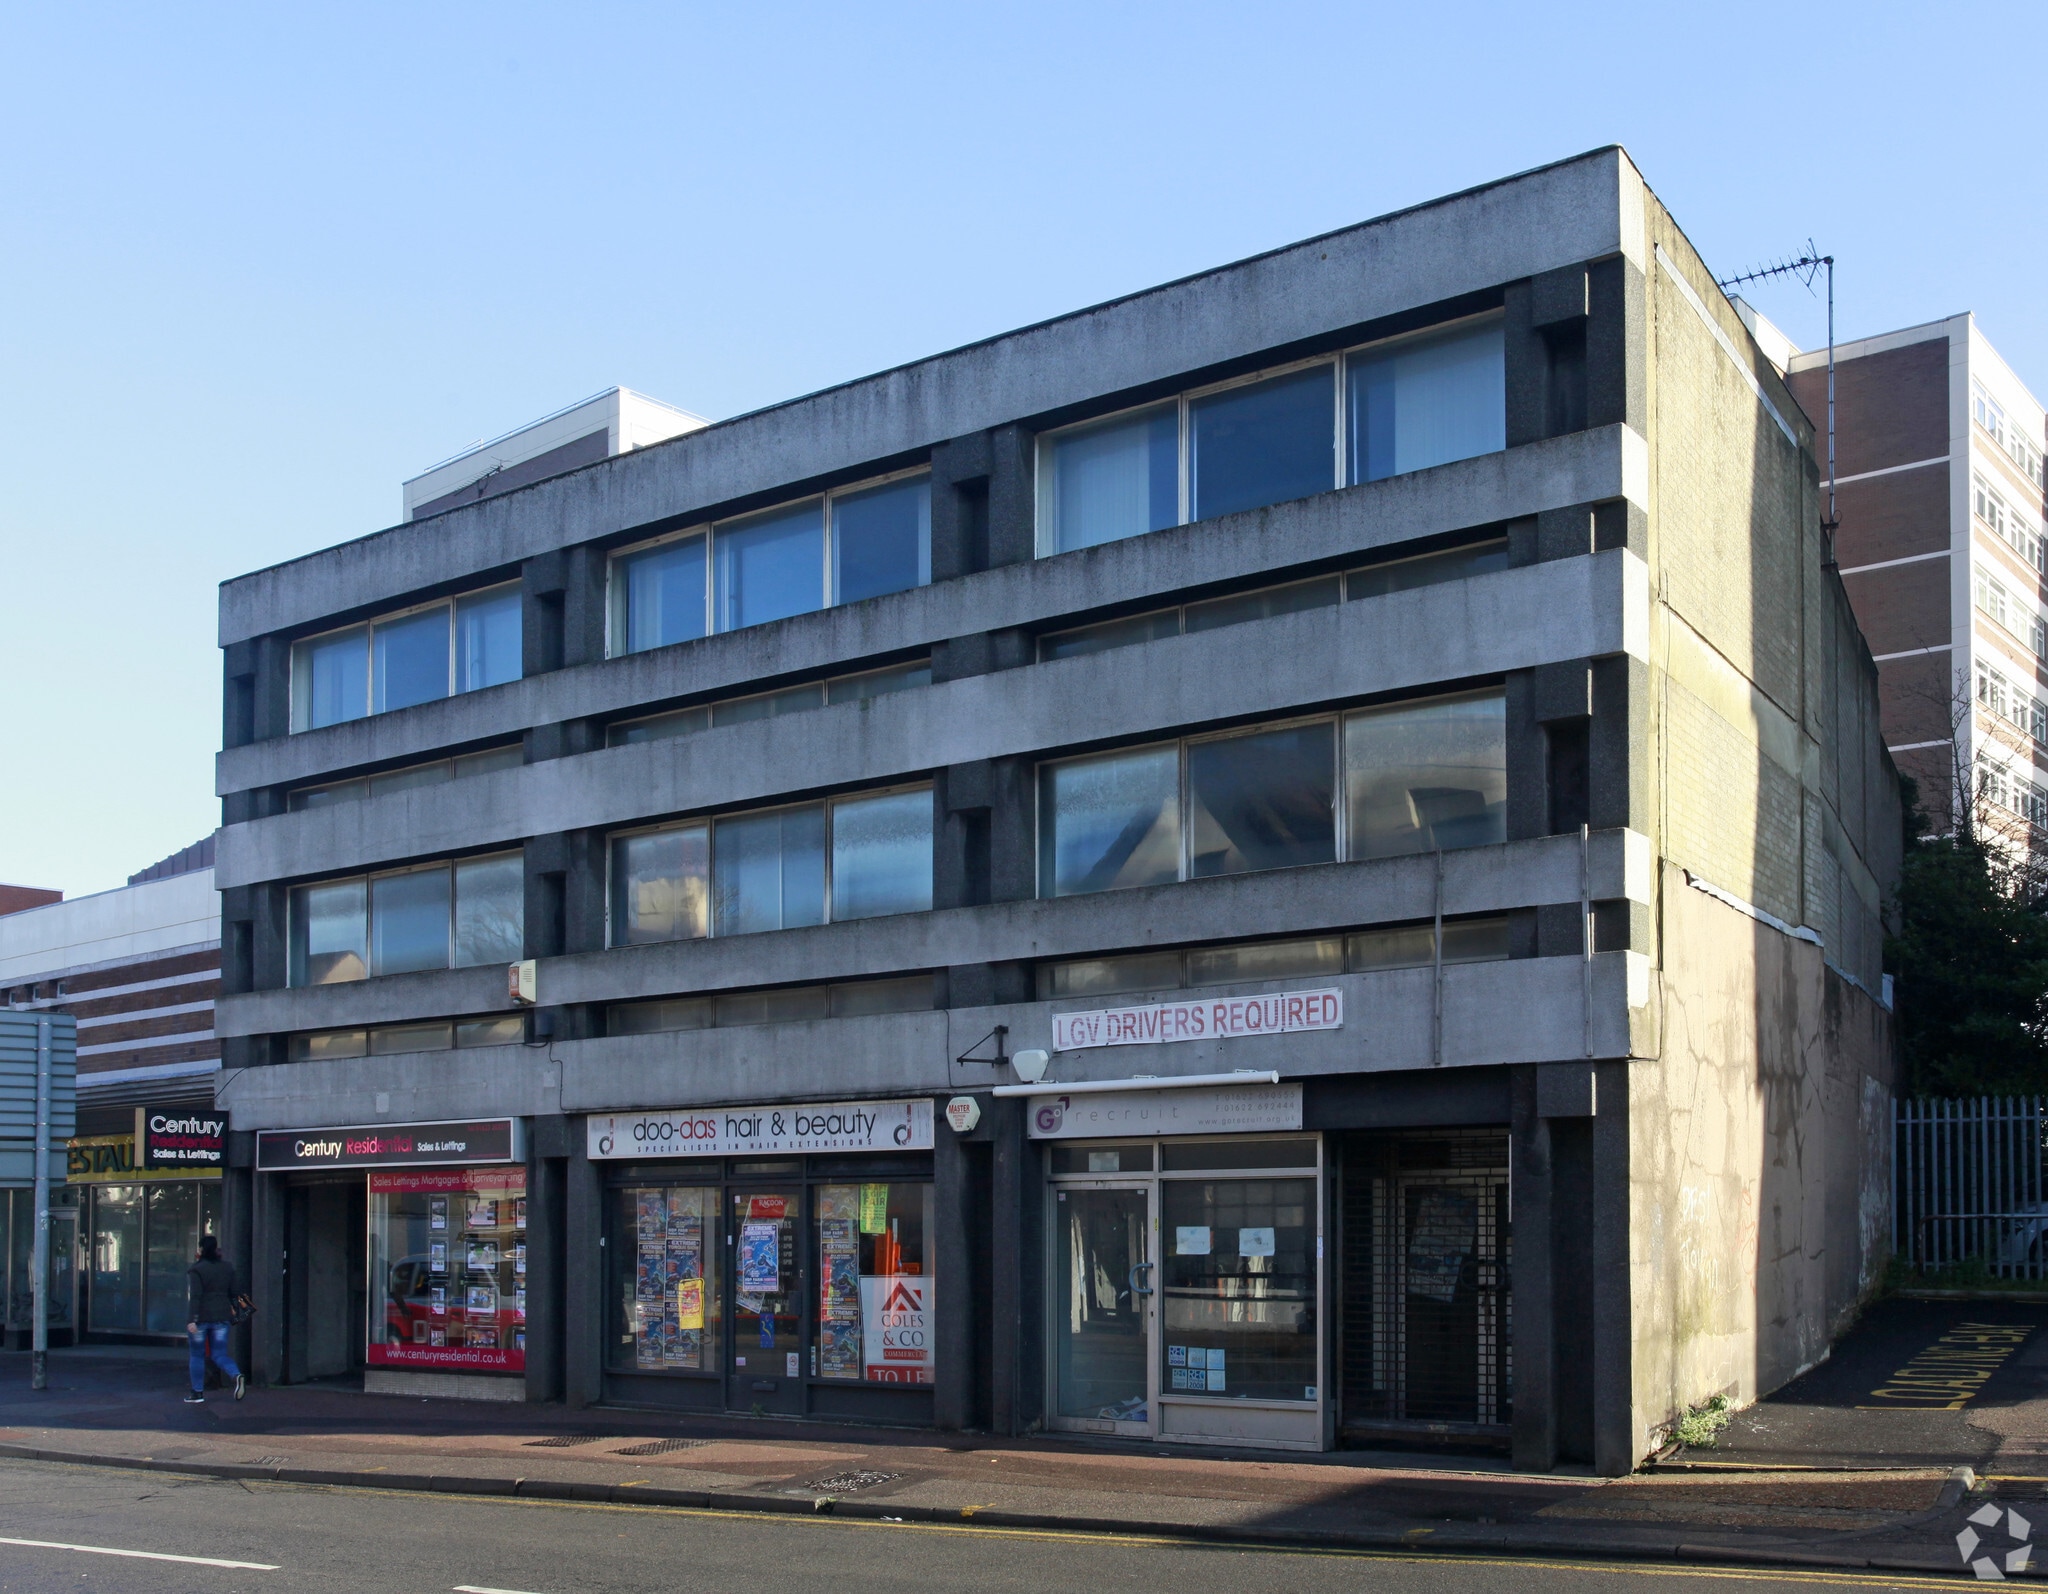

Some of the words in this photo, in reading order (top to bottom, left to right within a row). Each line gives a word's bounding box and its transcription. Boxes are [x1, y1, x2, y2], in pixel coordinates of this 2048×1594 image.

[1057, 1015, 1099, 1047] LGV
[1107, 1005, 1205, 1043] DRIVERS
[1213, 993, 1338, 1033] REQUIRED
[948, 1104, 970, 1112] MASTER
[1075, 1104, 1180, 1122] recruit
[150, 1115, 224, 1138] Century
[633, 1115, 717, 1141] doo-das
[725, 1113, 763, 1138] hair
[771, 1111, 786, 1136] &
[795, 1108, 876, 1139] beauty
[151, 1135, 223, 1149] Residential
[294, 1139, 343, 1159] Century
[346, 1135, 413, 1155] Residential
[417, 1142, 434, 1152] Sales
[435, 1142, 441, 1151] &
[441, 1141, 466, 1153] Lettings
[637, 1143, 717, 1153] SPECIALISTS
[789, 1137, 873, 1148] EXTENSIONS
[153, 1149, 177, 1159] Sales
[178, 1149, 186, 1159] &
[187, 1149, 221, 1161] Lettings
[373, 1176, 391, 1187] Sales
[393, 1176, 420, 1188] Lettings
[421, 1175, 460, 1187] Mortgages
[462, 1174, 468, 1183] &
[881, 1314, 924, 1327] COLES
[883, 1330, 895, 1346] &
[899, 1330, 924, 1346] CO
[386, 1349, 507, 1364] www.centuryresidential.co.uk
[1854, 1346, 2015, 1411] LOADING
[1938, 1322, 2037, 1343] BAY
[873, 1369, 899, 1383] TO
